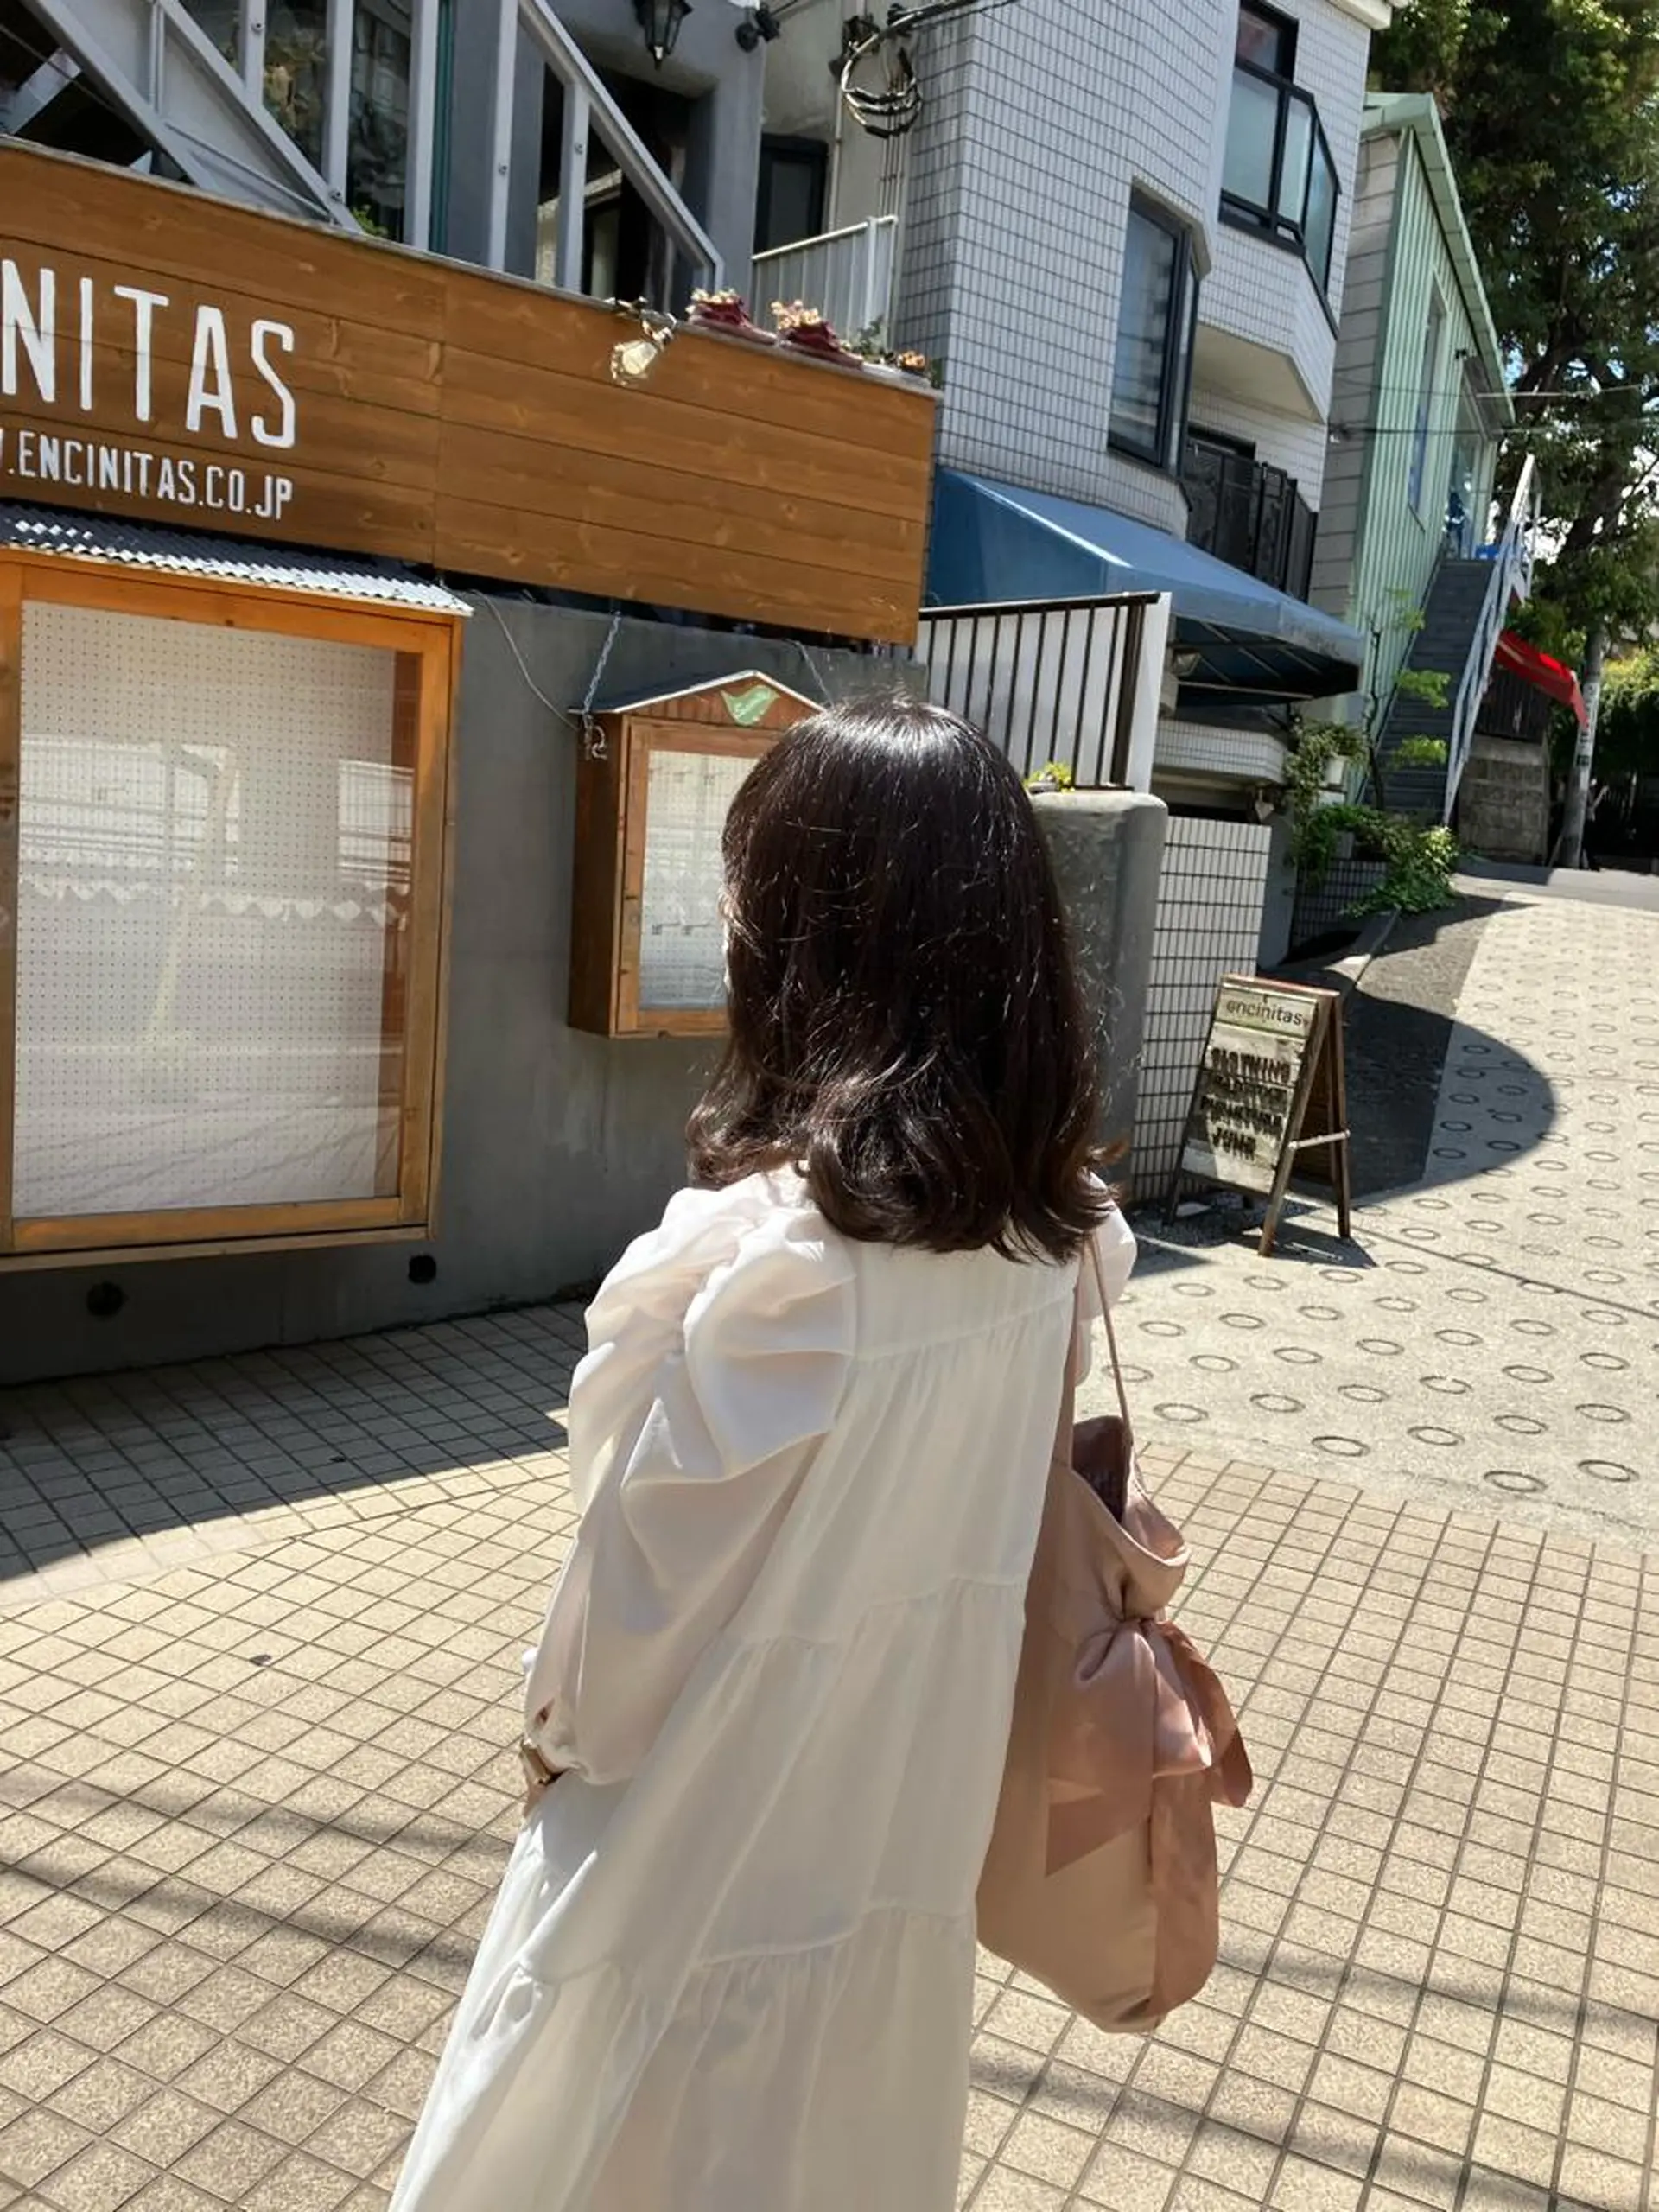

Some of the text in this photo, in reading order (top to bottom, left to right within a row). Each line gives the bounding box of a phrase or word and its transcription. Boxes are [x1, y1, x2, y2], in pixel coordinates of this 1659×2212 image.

[2, 259, 295, 448] NITAS
[0, 427, 293, 520] .ENCINITAS.CO.JP
[1226, 1000, 1303, 1026] encinitas
